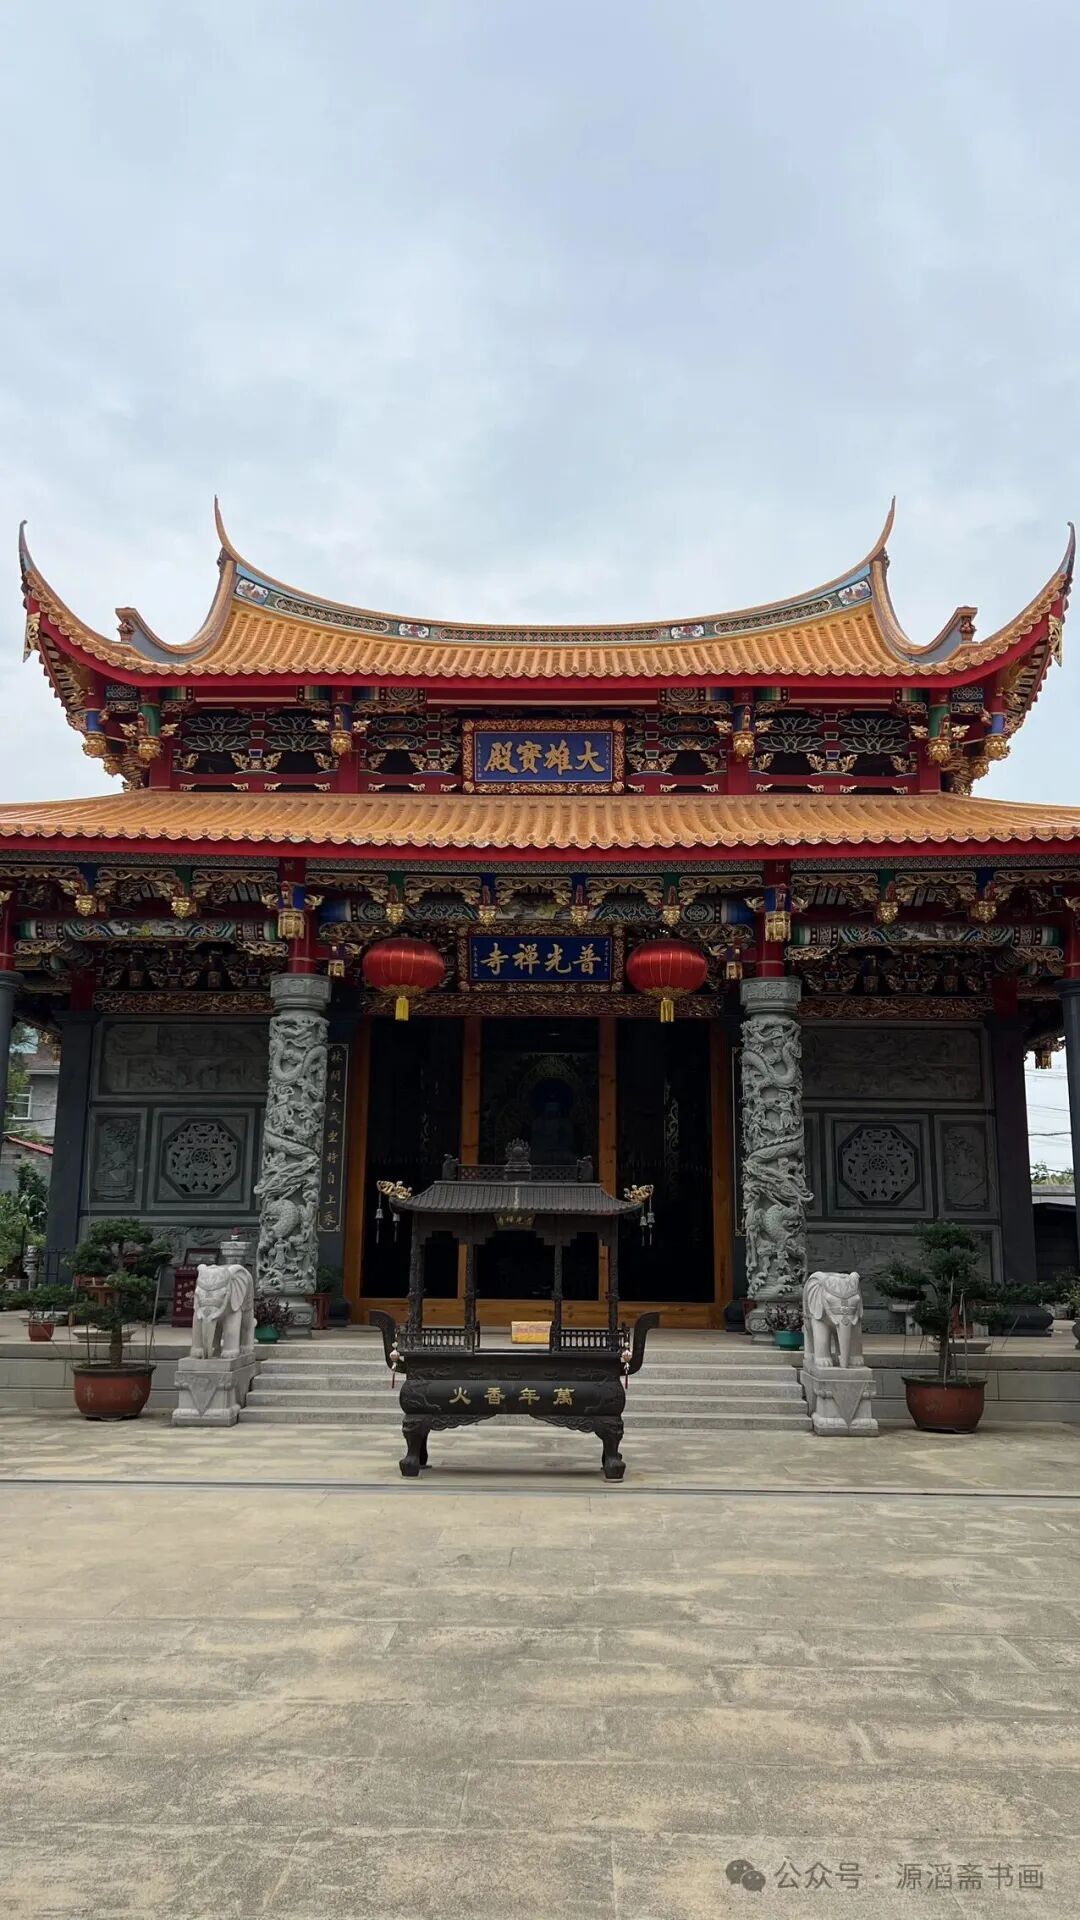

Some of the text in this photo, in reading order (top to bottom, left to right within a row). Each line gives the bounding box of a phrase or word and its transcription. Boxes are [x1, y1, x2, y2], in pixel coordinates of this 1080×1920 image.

[484, 738, 606, 776] 大雄寶殿
[480, 942, 602, 975] 普光禪寺
[449, 1386, 576, 1407] 萬年香火
